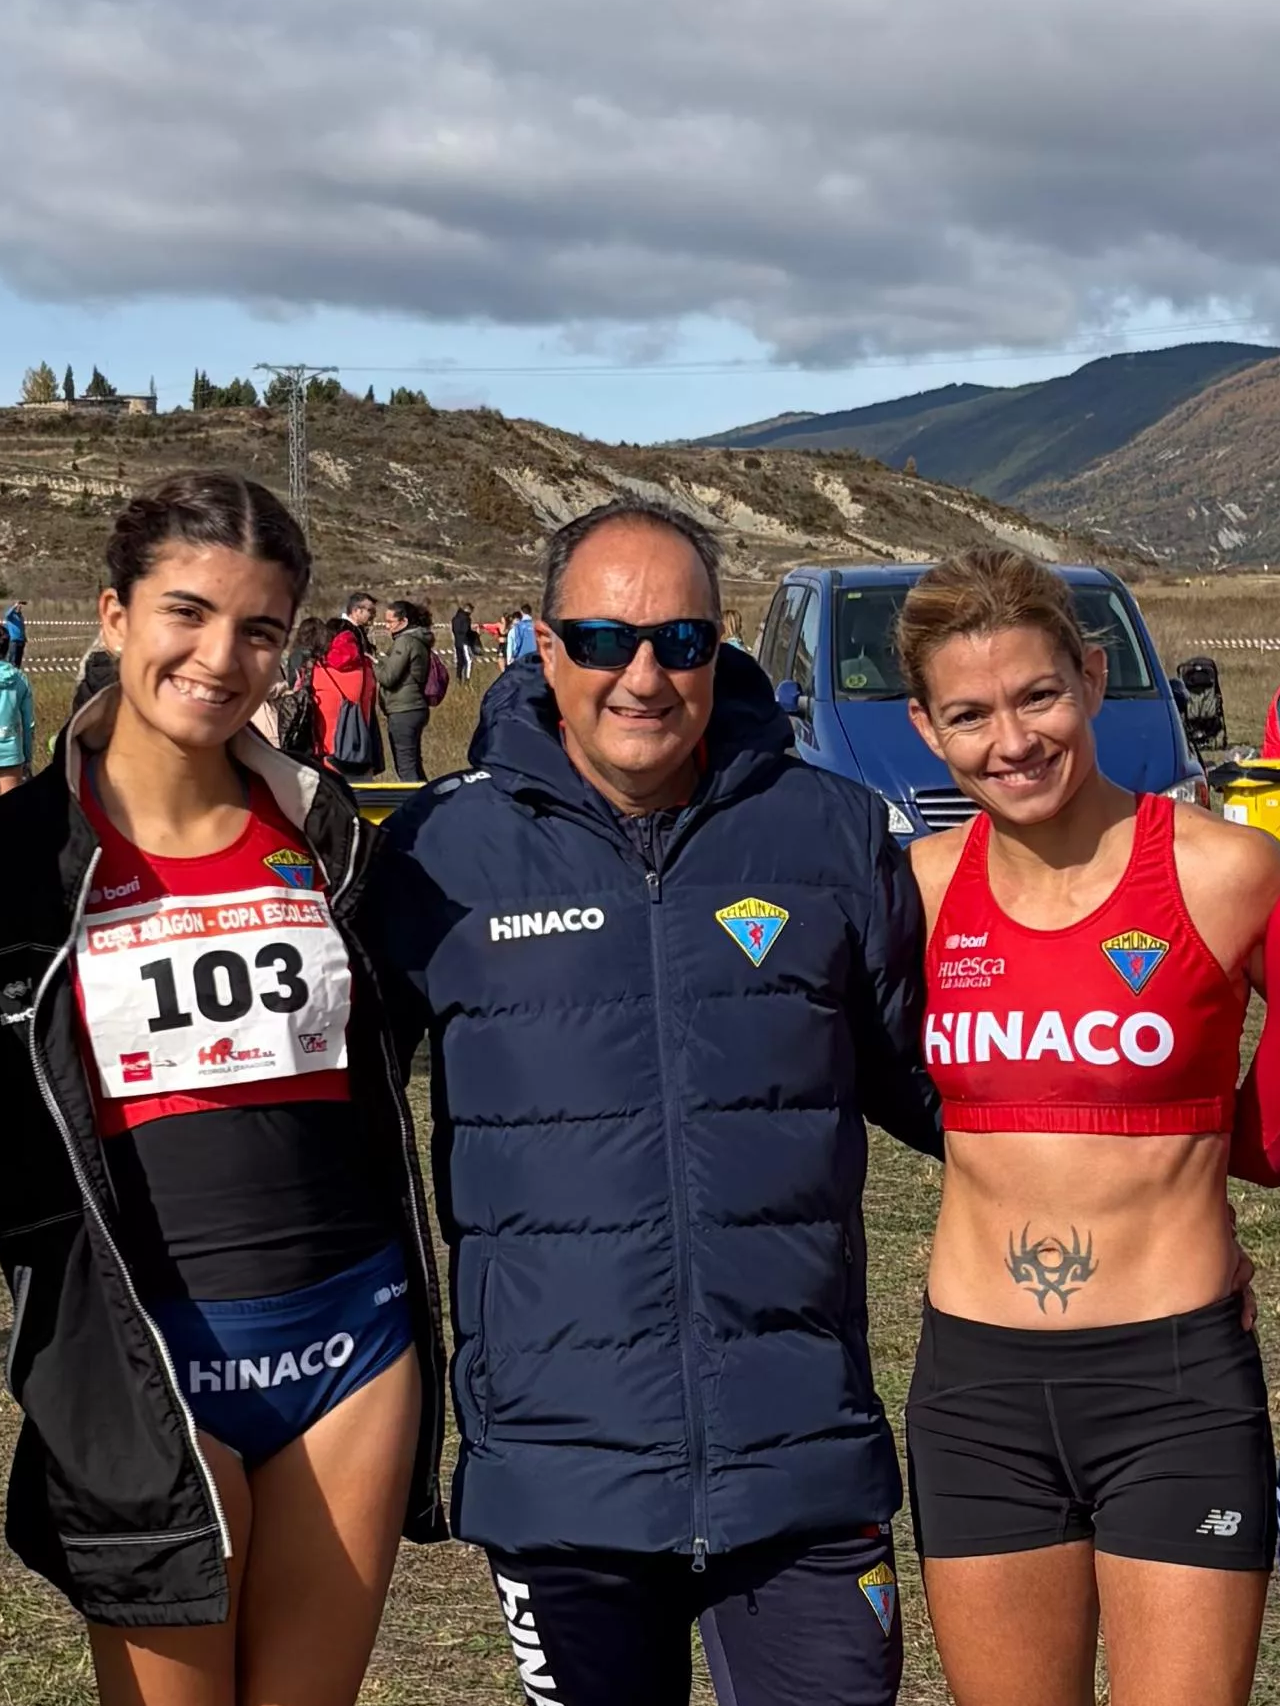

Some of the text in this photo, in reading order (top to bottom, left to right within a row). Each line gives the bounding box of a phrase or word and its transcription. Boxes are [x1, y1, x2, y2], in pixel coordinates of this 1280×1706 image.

[91, 927, 137, 951] COPA
[140, 907, 205, 942] ARAGÓN
[217, 909, 259, 930] COPA
[263, 902, 324, 924] ESCOLAR
[489, 907, 605, 942] HINACO
[140, 942, 308, 1033] 103
[937, 957, 1005, 978] Huesca
[925, 1010, 1175, 1067] HINACO
[188, 1332, 355, 1394] HINACO
